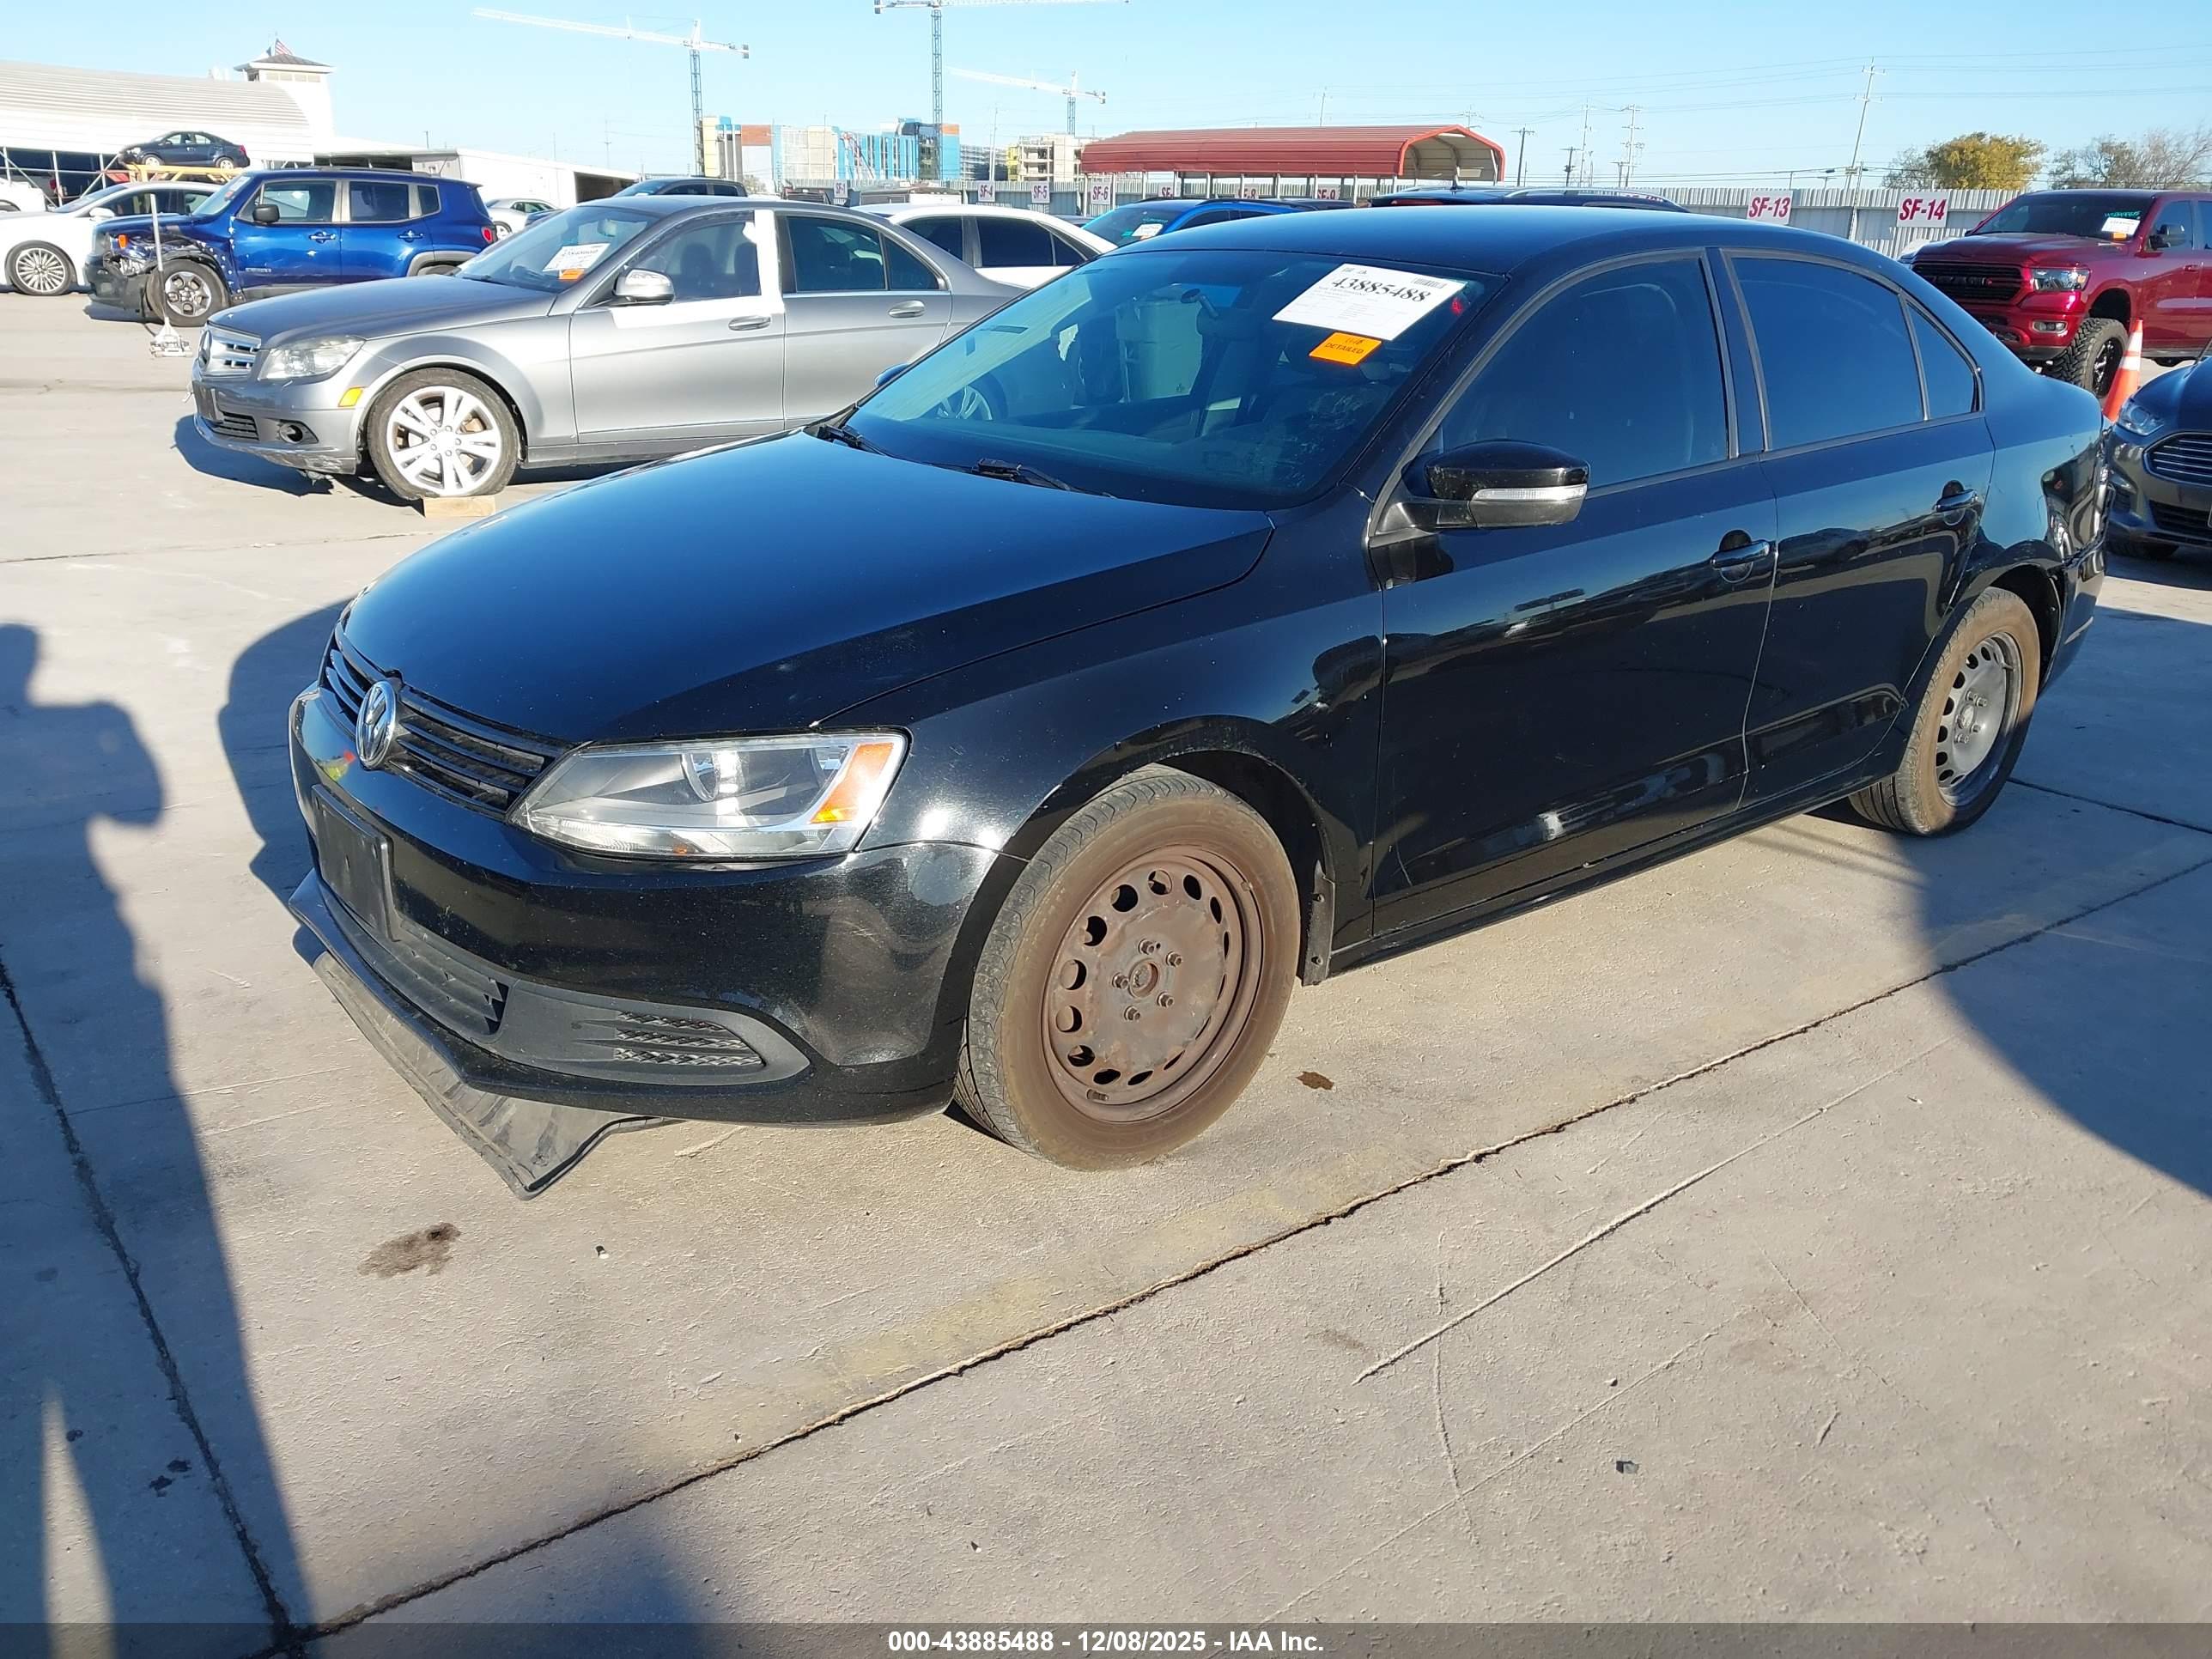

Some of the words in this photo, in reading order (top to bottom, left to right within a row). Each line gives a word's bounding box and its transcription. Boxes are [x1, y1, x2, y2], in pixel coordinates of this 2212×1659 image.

[980, 185, 994, 198] SF-4
[1033, 185, 1048, 198] SF-5
[1092, 185, 1109, 200] SF-6
[1748, 197, 1791, 218] SF-13
[1899, 198, 1946, 221] SF-14
[1332, 276, 1431, 302] 43885488
